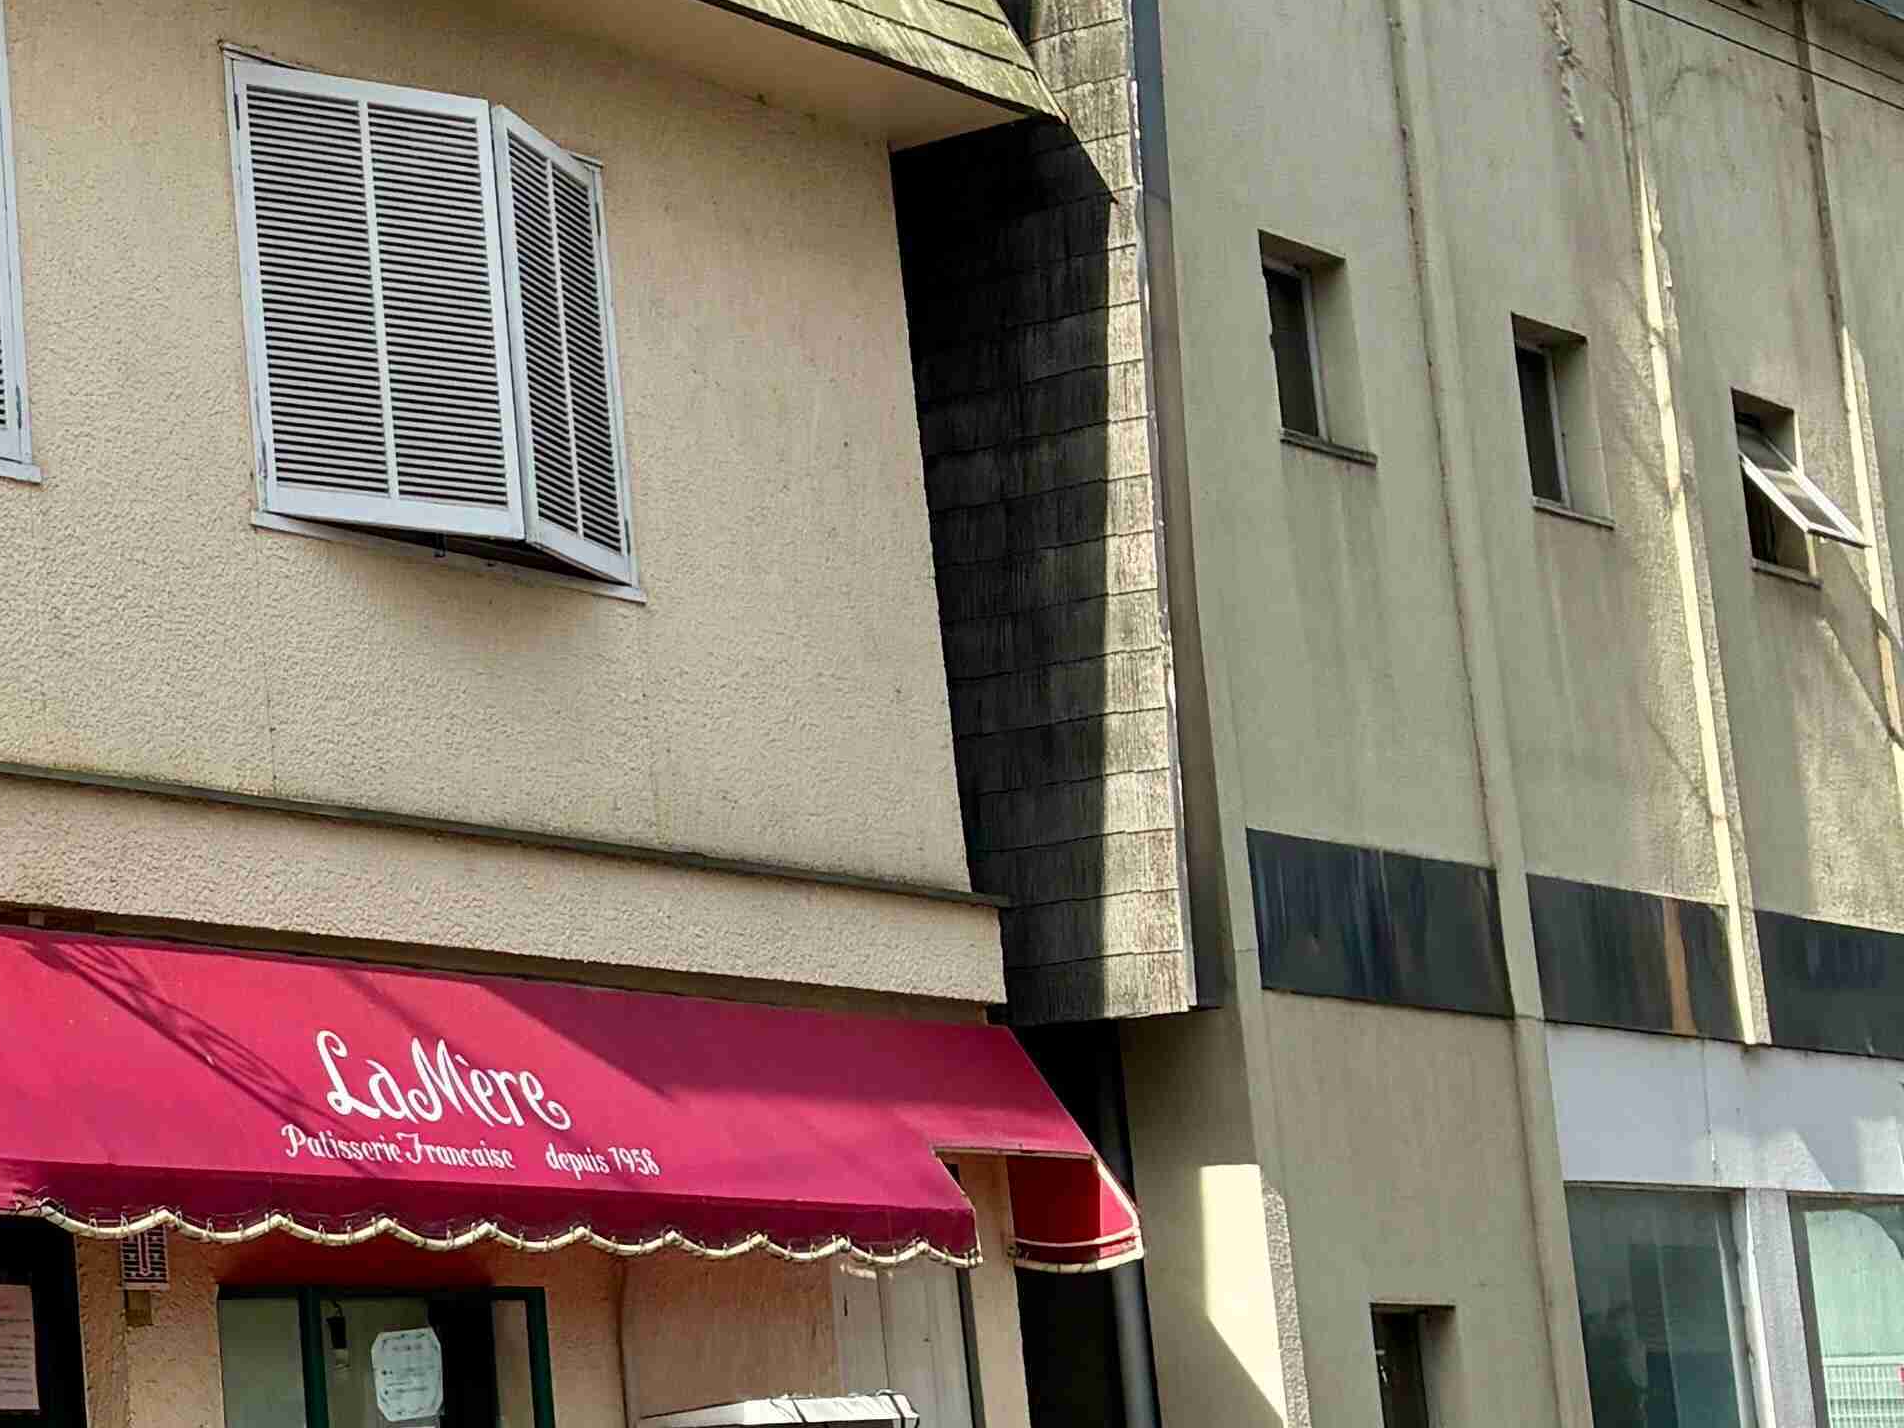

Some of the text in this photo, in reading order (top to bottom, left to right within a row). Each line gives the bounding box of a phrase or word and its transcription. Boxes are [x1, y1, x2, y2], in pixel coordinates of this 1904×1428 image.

[281, 1122, 402, 1163] Patisserie
[399, 1132, 516, 1169] Francaise
[545, 1142, 609, 1181] depuis
